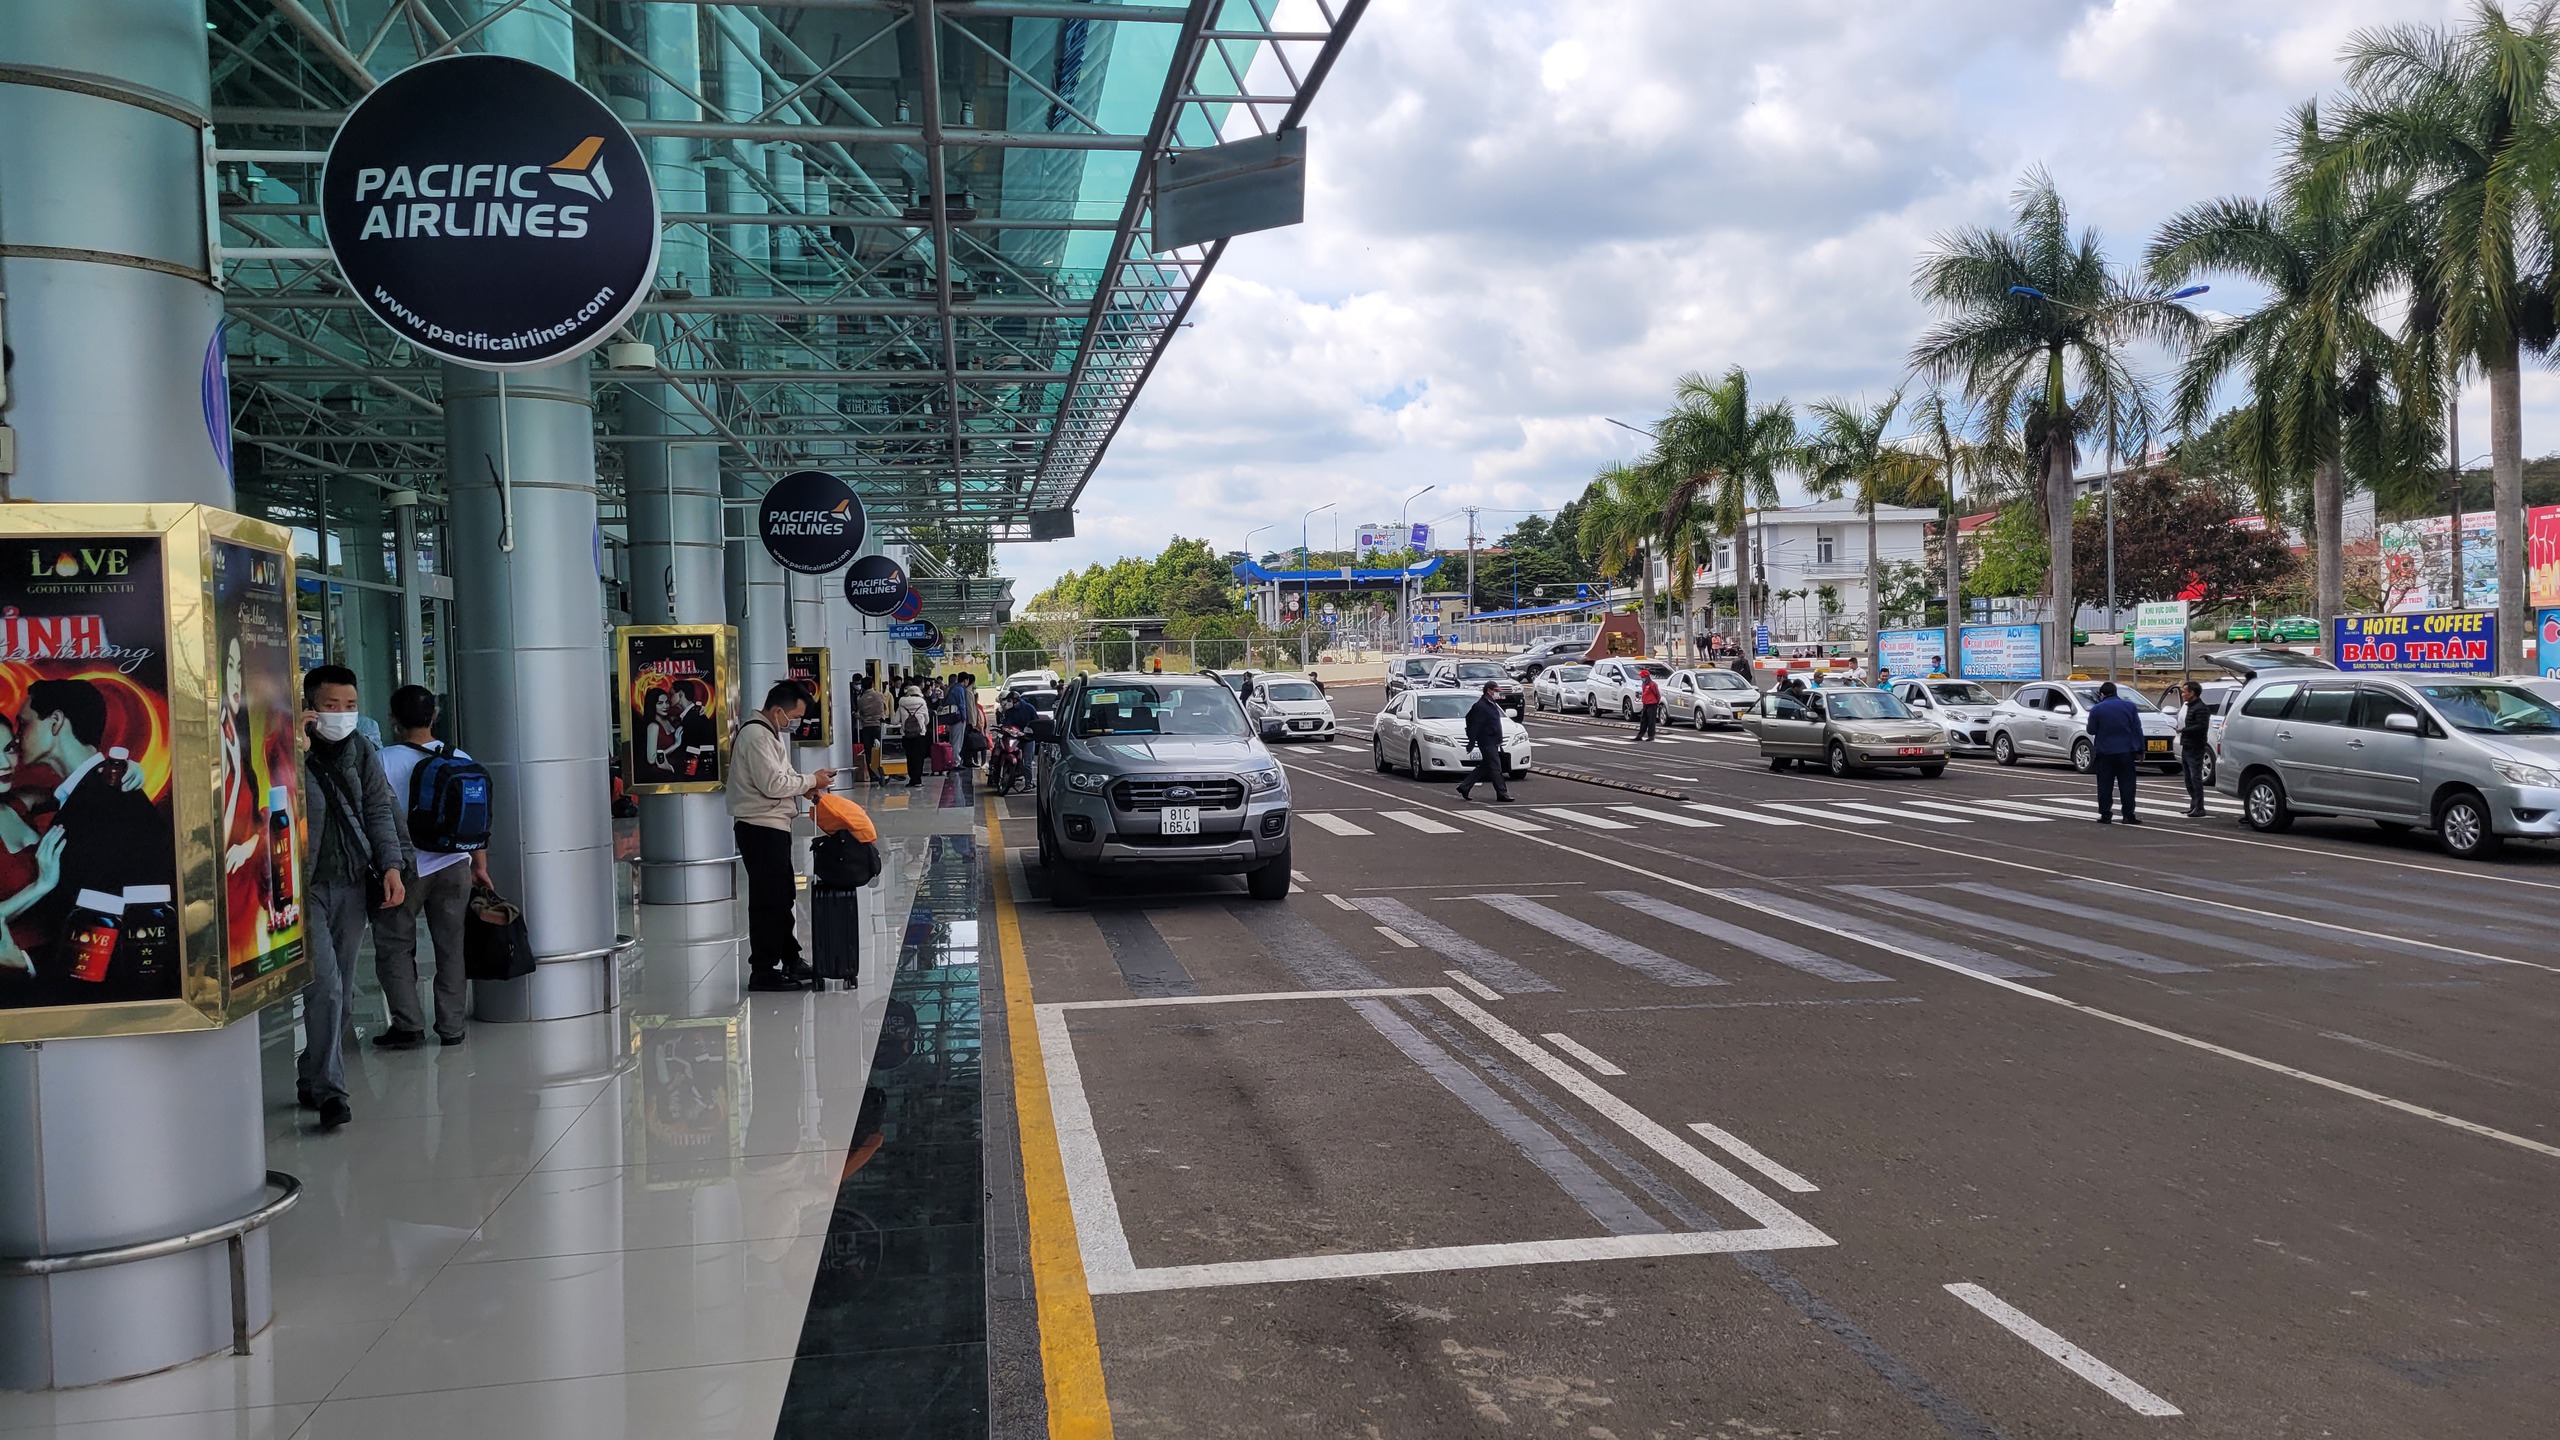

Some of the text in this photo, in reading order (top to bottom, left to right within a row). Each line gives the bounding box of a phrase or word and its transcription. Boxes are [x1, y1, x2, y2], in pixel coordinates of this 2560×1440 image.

[356, 164, 542, 202] PACIFIC
[359, 202, 589, 240] AIRLINES
[374, 284, 616, 351] www.pacificairlines.com
[769, 510, 829, 523] PACIFIC
[769, 523, 844, 536] AIRLINES
[31, 549, 129, 577] LOVE
[773, 549, 851, 571] www.pacificairlines.com
[250, 558, 276, 586] LOVE
[26, 584, 134, 594] GOOD FOR HEALTH
[851, 578, 889, 588] PACIFIC
[852, 585, 897, 596] AIRLINES
[2362, 617, 2408, 635] HOTEL
[2424, 614, 2483, 633] COFFEE
[1917, 632, 1929, 641] ACV
[2007, 628, 2022, 638] ACV
[673, 638, 703, 648] LOVE
[2343, 636, 2487, 662] BẢO TRÂN
[1170, 789, 1189, 798] Ford
[1170, 808, 1191, 821] 81C
[1163, 820, 1198, 833] 165.41
[71, 929, 110, 947] LOVE
[128, 926, 166, 939] LOVE
